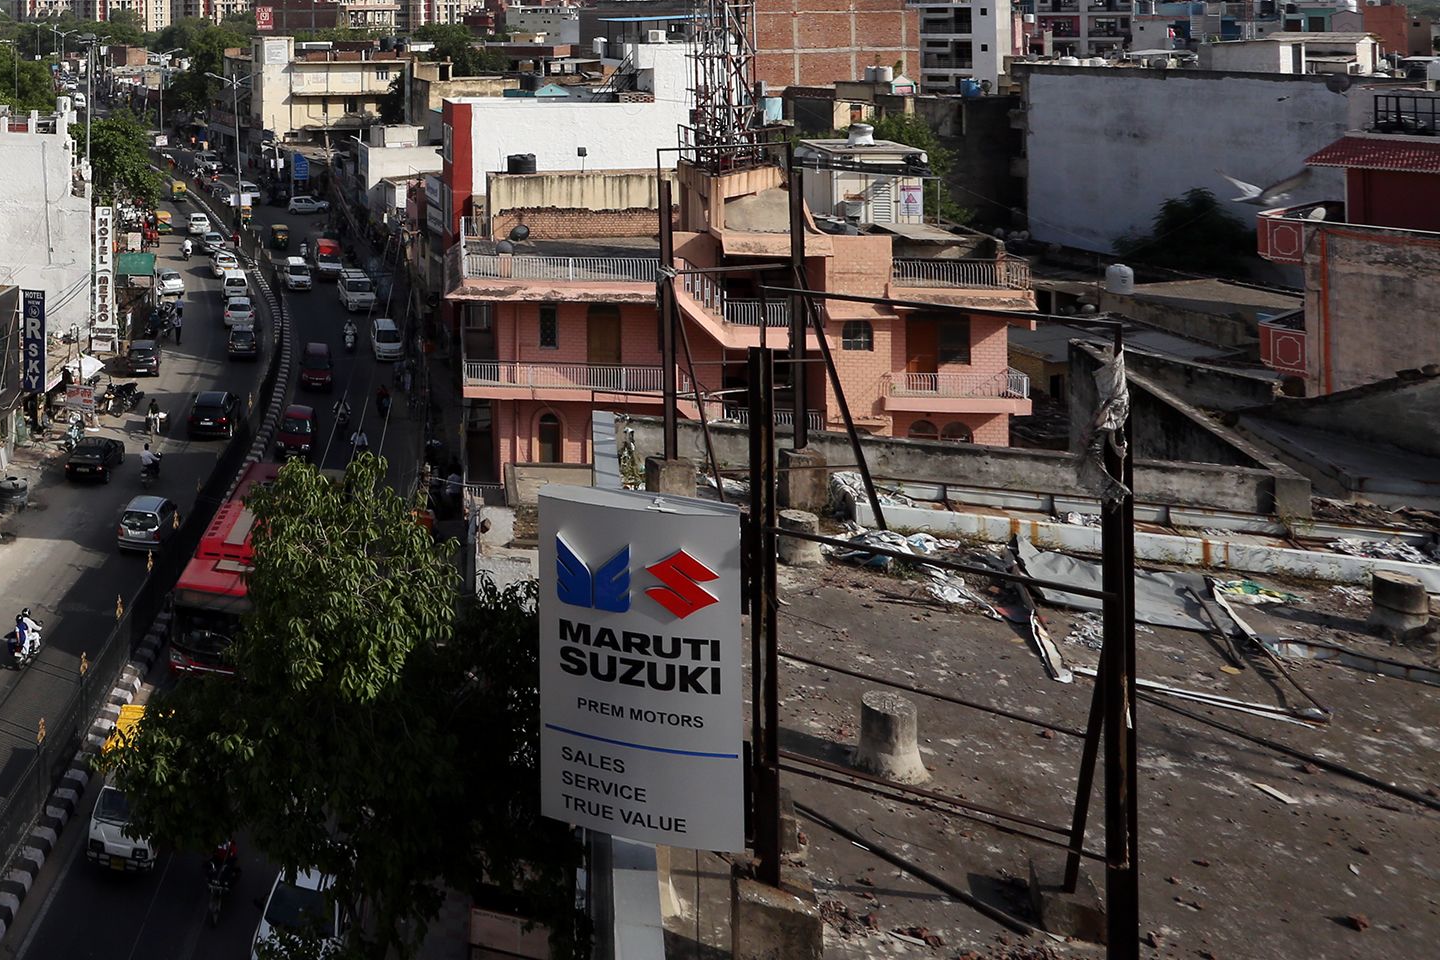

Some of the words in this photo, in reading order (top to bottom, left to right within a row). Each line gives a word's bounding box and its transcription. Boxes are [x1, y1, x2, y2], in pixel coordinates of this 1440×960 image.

[98, 218, 108, 264] HOTEL
[25, 291, 43, 299] HOTEL
[98, 276, 108, 322] METRO
[26, 318, 41, 339] R
[29, 343, 40, 389] SKY
[559, 618, 720, 662] MARUTI
[560, 645, 721, 695] SUZUKI
[577, 697, 624, 718] PREM
[630, 708, 704, 729] MOTORS
[561, 746, 625, 774] SALES
[562, 770, 647, 803] SERVICE
[561, 793, 614, 820] TRUE
[620, 808, 687, 833] VALUE
